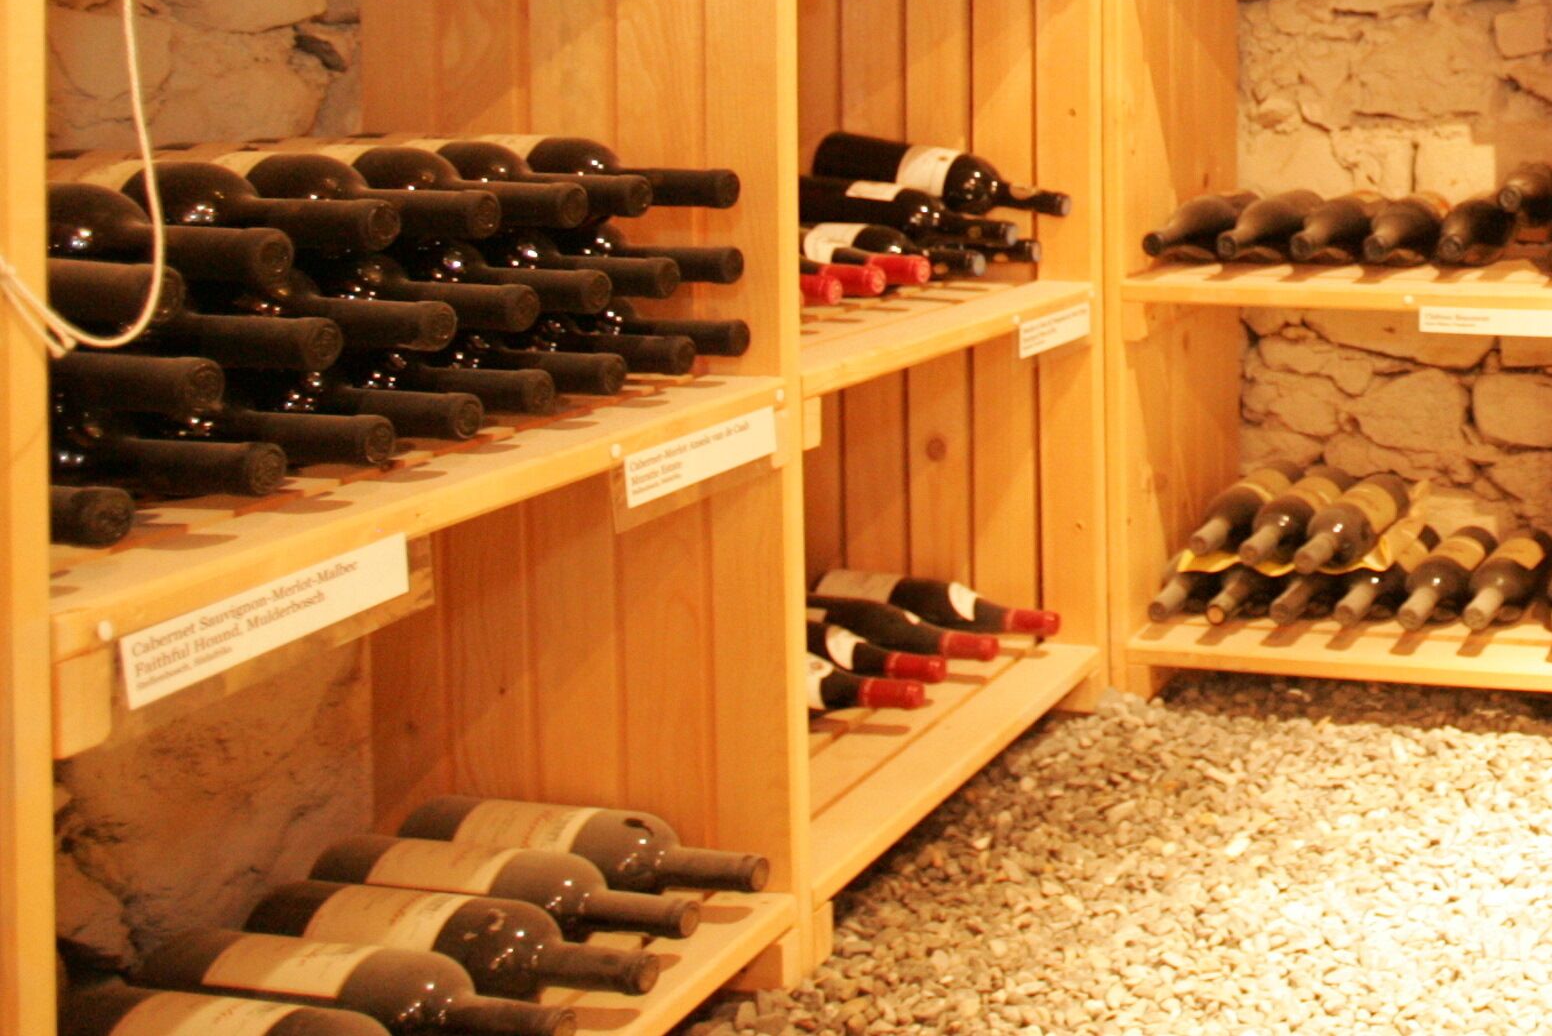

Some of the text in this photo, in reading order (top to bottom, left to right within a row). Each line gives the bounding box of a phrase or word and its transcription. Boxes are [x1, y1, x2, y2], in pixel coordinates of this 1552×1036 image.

[132, 623, 196, 657] Cabernet
[134, 642, 190, 677] Faithful
[247, 590, 325, 630] Mulderbosch
